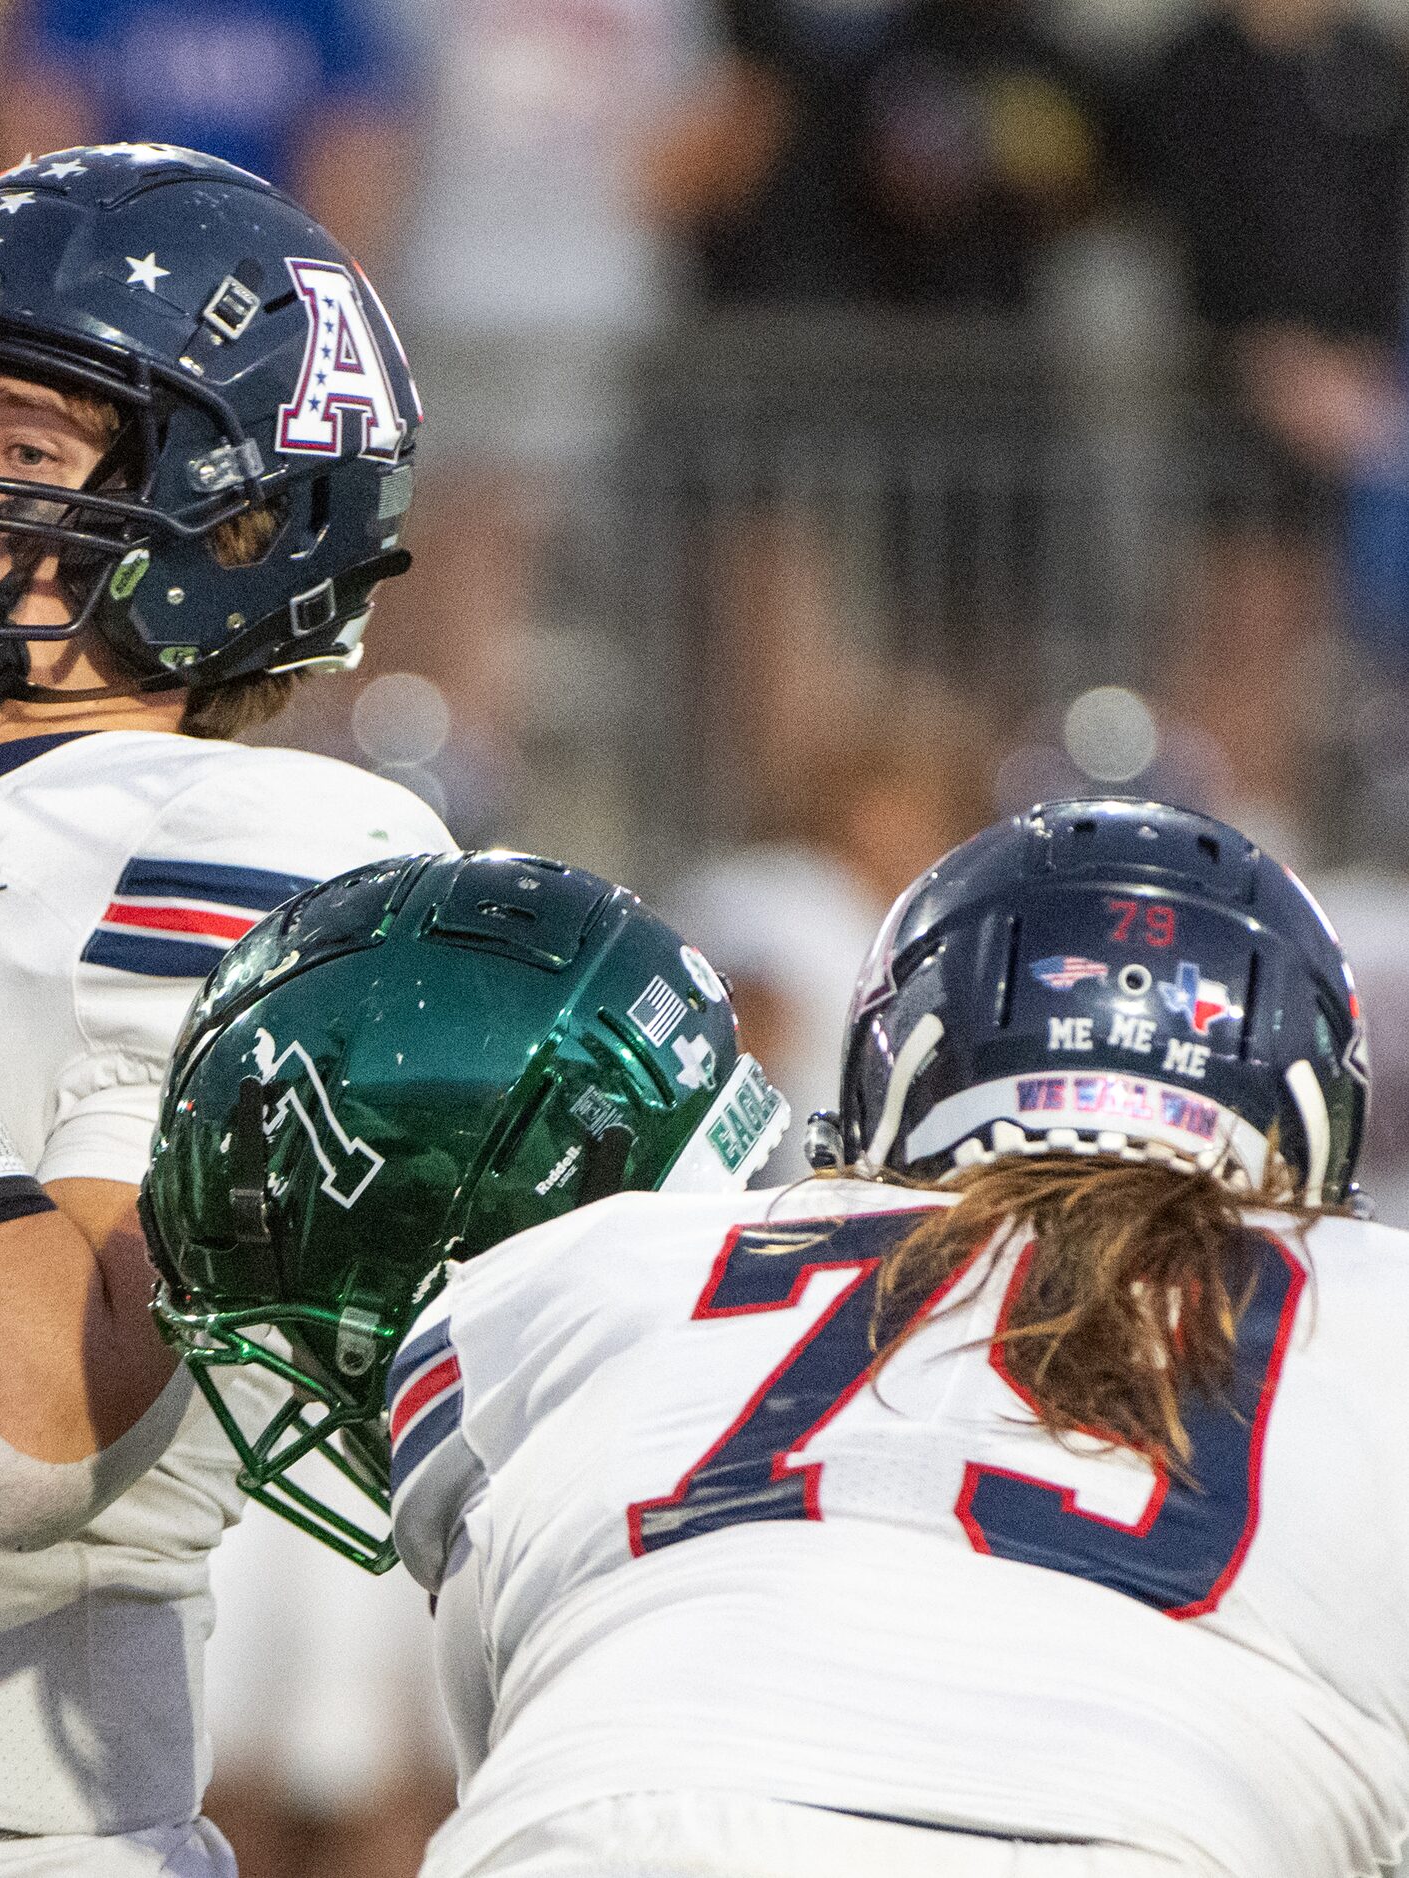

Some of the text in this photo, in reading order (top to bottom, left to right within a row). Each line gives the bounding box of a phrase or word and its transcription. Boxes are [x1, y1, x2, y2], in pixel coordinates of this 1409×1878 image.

[275, 257, 407, 464] A
[1108, 899, 1176, 947] 79
[1047, 1013, 1212, 1080] ME ME ME
[1016, 1077, 1067, 1112] WE
[1160, 1088, 1219, 1142] WIN
[534, 1144, 581, 1197] Riddell
[627, 1207, 1308, 1621] 79
